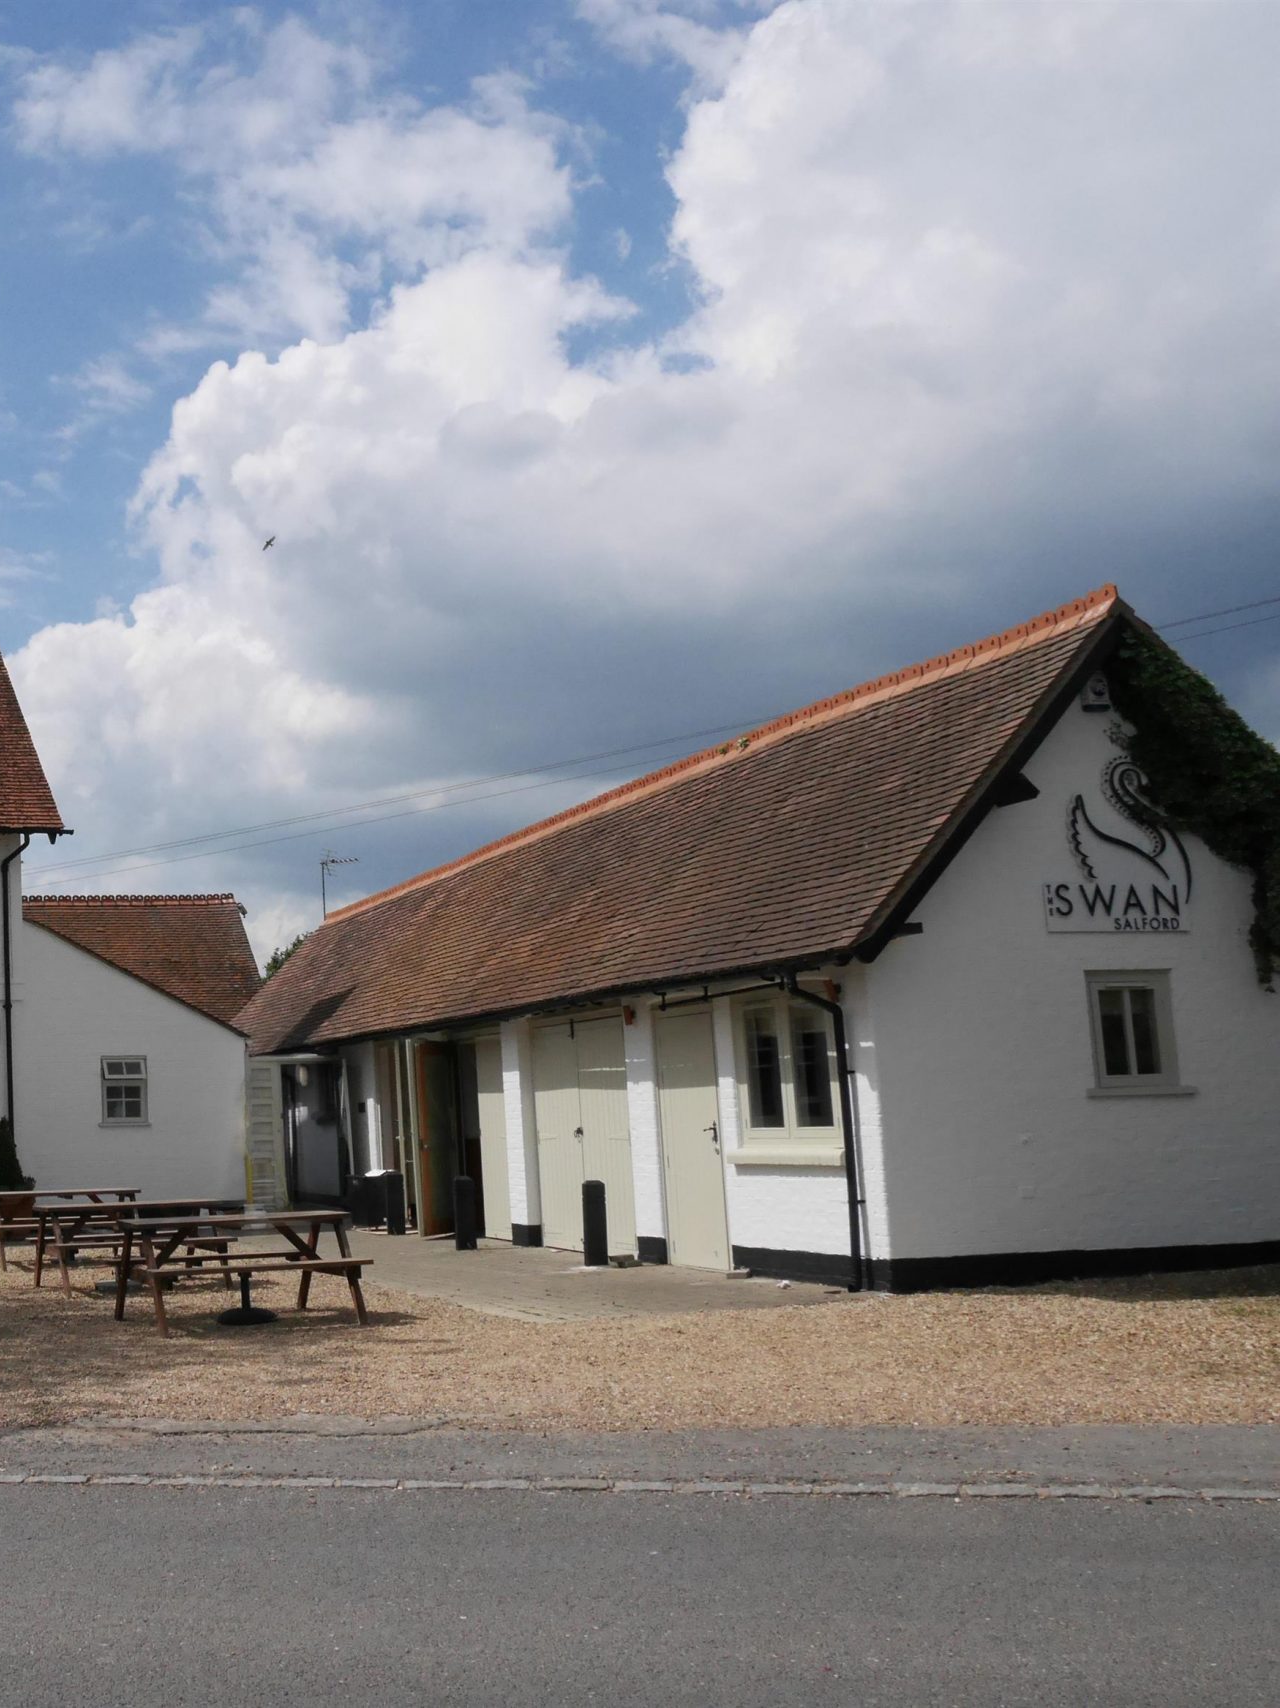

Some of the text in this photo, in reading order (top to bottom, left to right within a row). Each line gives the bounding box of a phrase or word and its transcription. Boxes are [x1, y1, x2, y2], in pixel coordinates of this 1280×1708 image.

[1046, 884, 1055, 916] THE
[1056, 883, 1180, 917] SWAN
[1114, 917, 1180, 930] SALFORD
